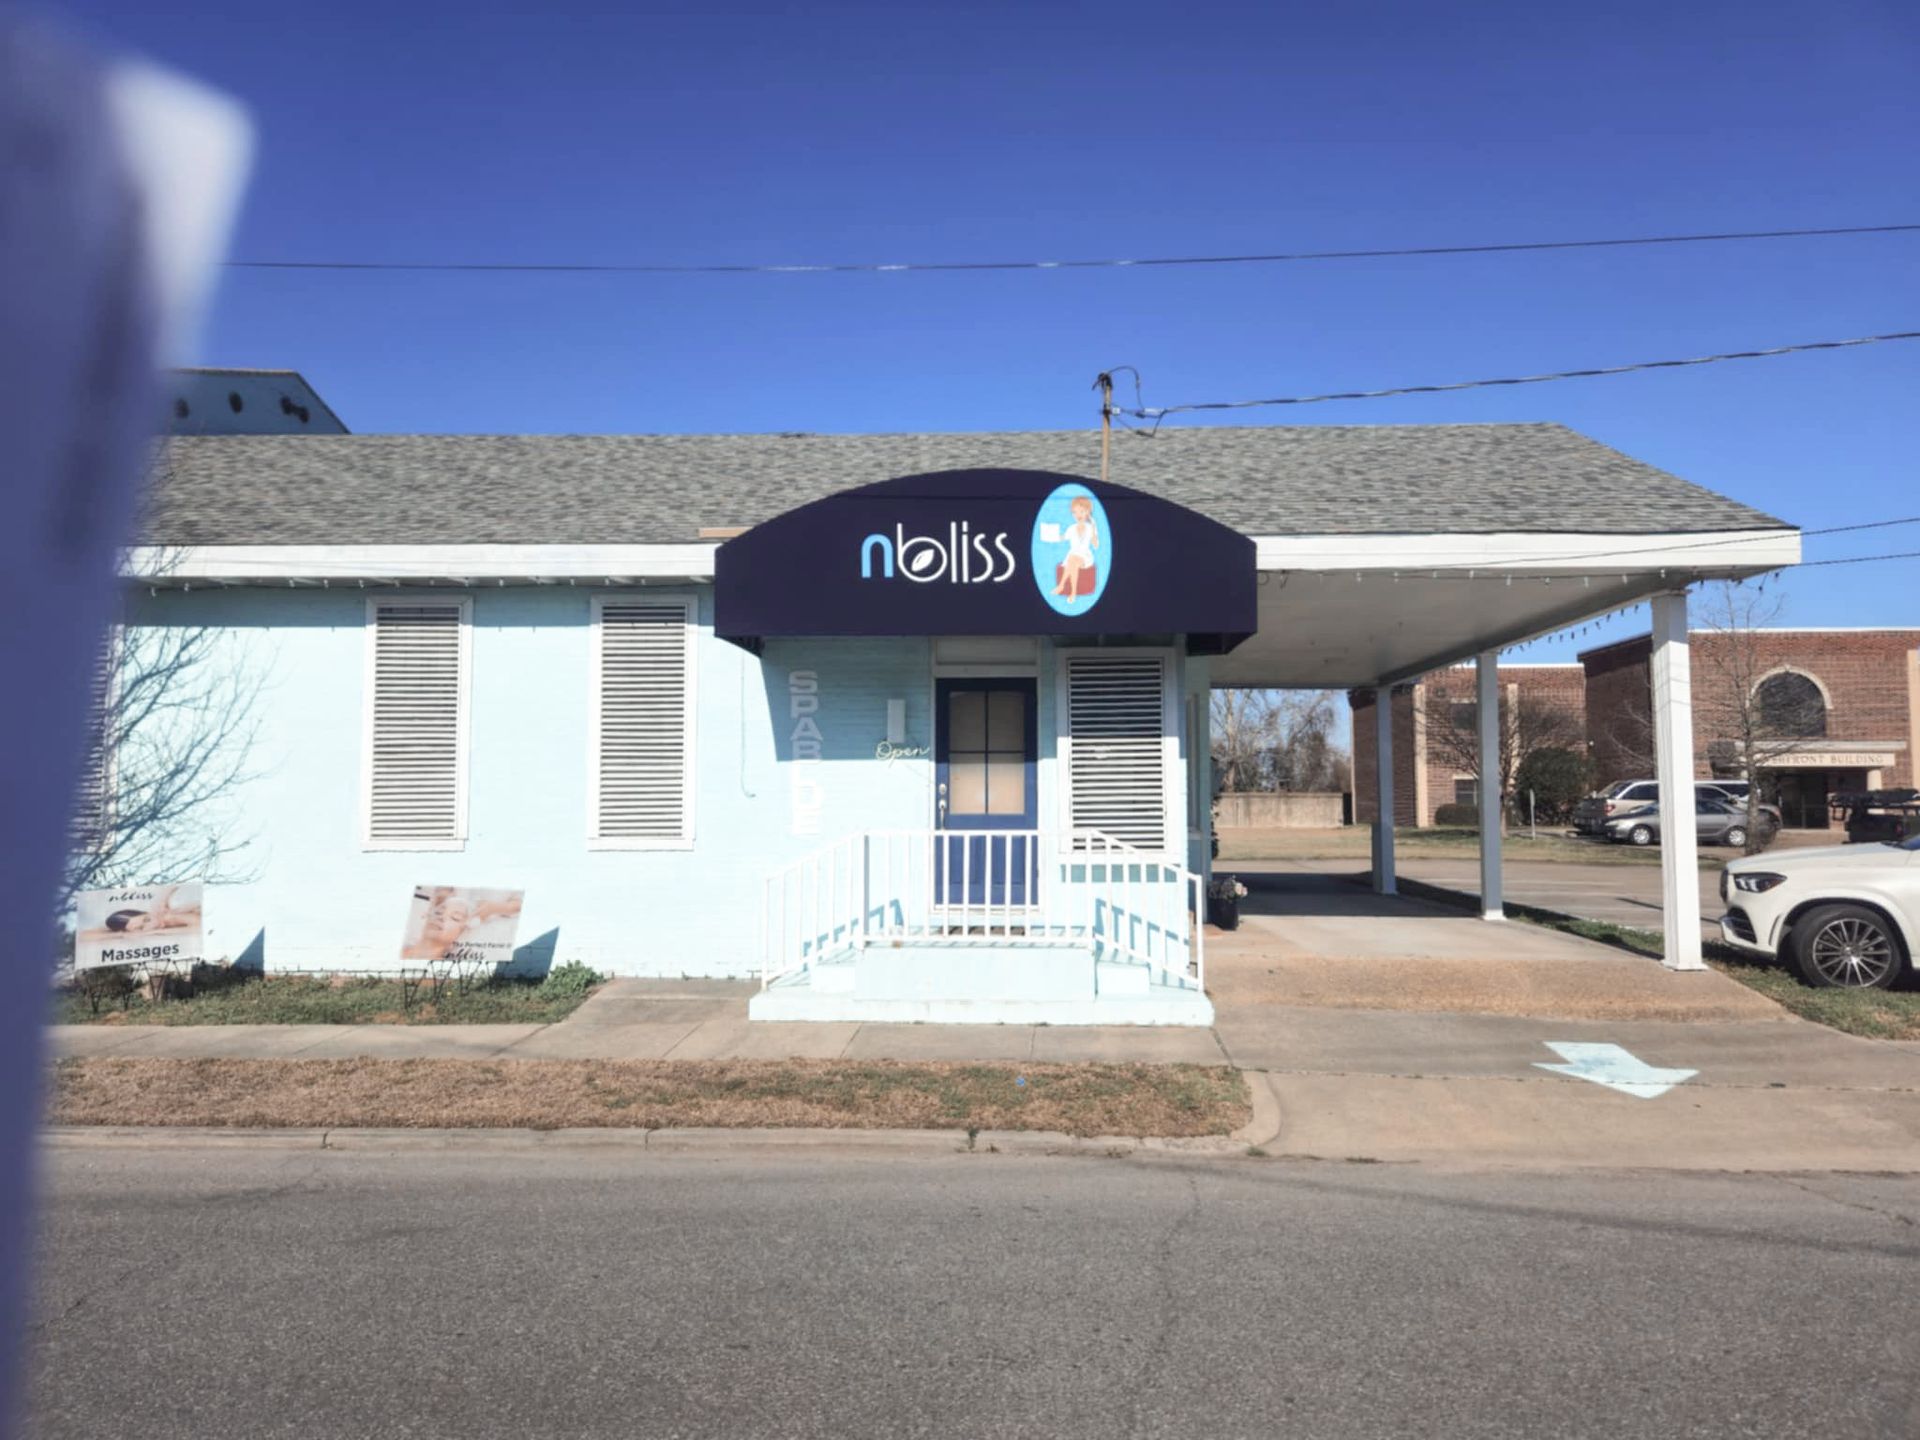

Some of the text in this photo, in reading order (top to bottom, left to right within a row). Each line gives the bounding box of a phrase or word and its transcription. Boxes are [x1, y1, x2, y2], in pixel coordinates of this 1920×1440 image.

[861, 520, 1016, 584] nbliss
[875, 740, 930, 768] Open
[1830, 754, 1884, 765] BUILDING
[101, 943, 180, 963] Massages
